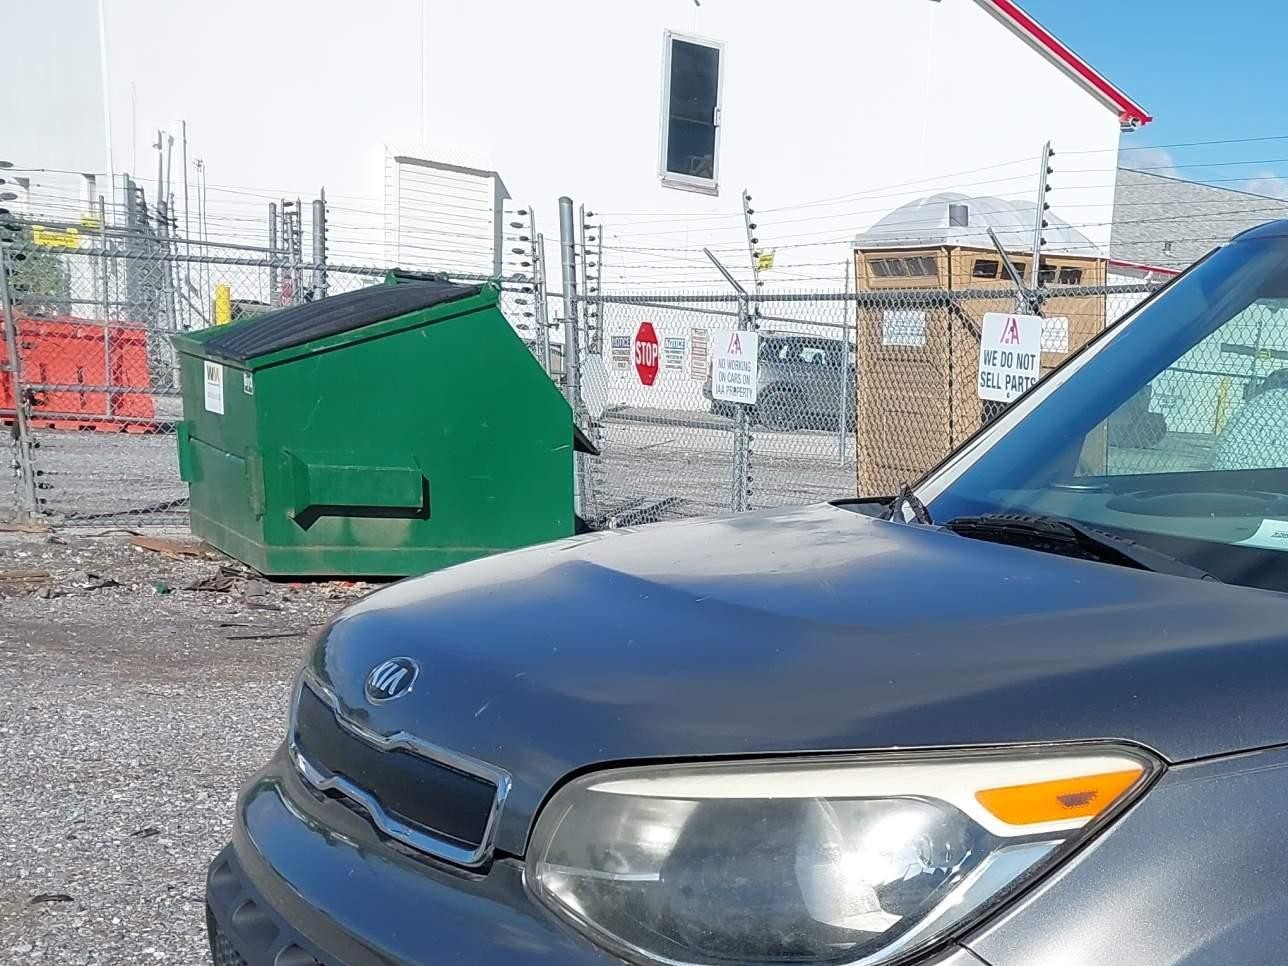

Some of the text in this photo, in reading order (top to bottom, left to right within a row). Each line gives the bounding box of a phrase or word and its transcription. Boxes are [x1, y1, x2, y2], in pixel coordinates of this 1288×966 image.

[636, 341, 658, 367] STOP
[983, 349, 1036, 370] WE DO NOT
[717, 359, 751, 372] NO WORKING
[718, 371, 751, 385] ON CARS ON
[980, 371, 1037, 392] SELL PARTS
[726, 385, 753, 398] PROPERTY
[368, 661, 408, 696] KIA
